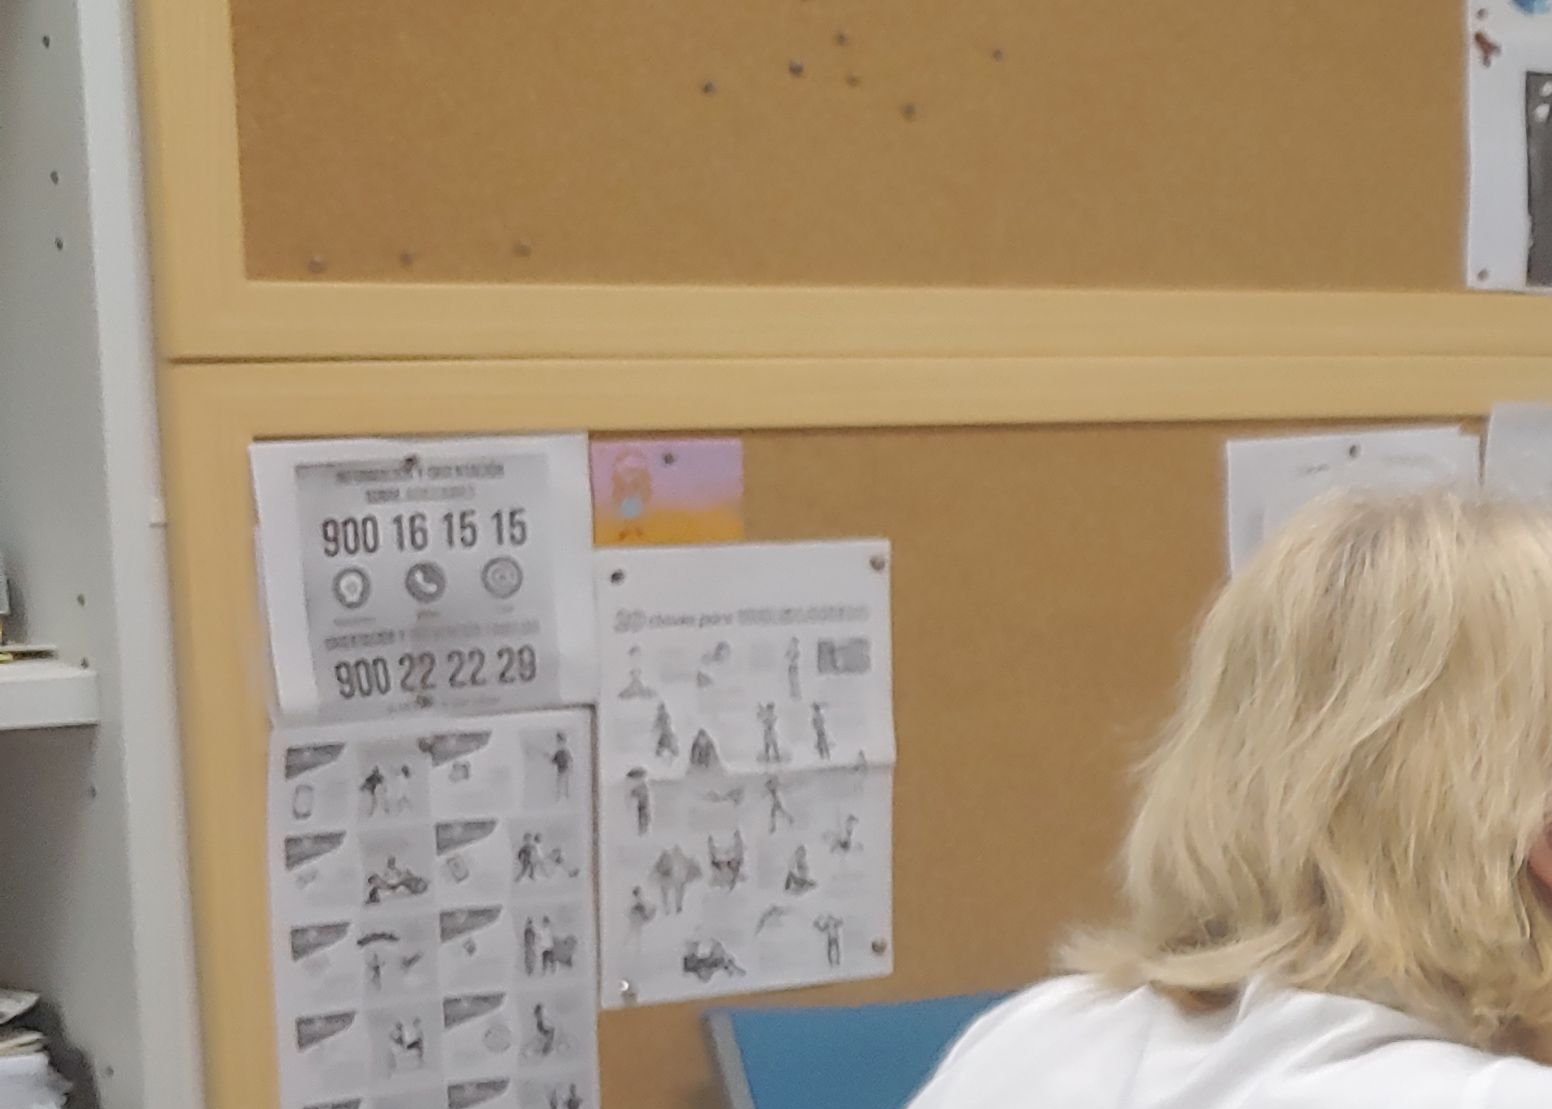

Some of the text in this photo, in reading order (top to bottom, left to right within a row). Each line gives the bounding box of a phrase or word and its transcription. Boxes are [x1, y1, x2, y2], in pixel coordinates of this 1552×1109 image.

[322, 507, 527, 557] 900 16 15 15
[334, 643, 537, 699] 900 22 22 29
